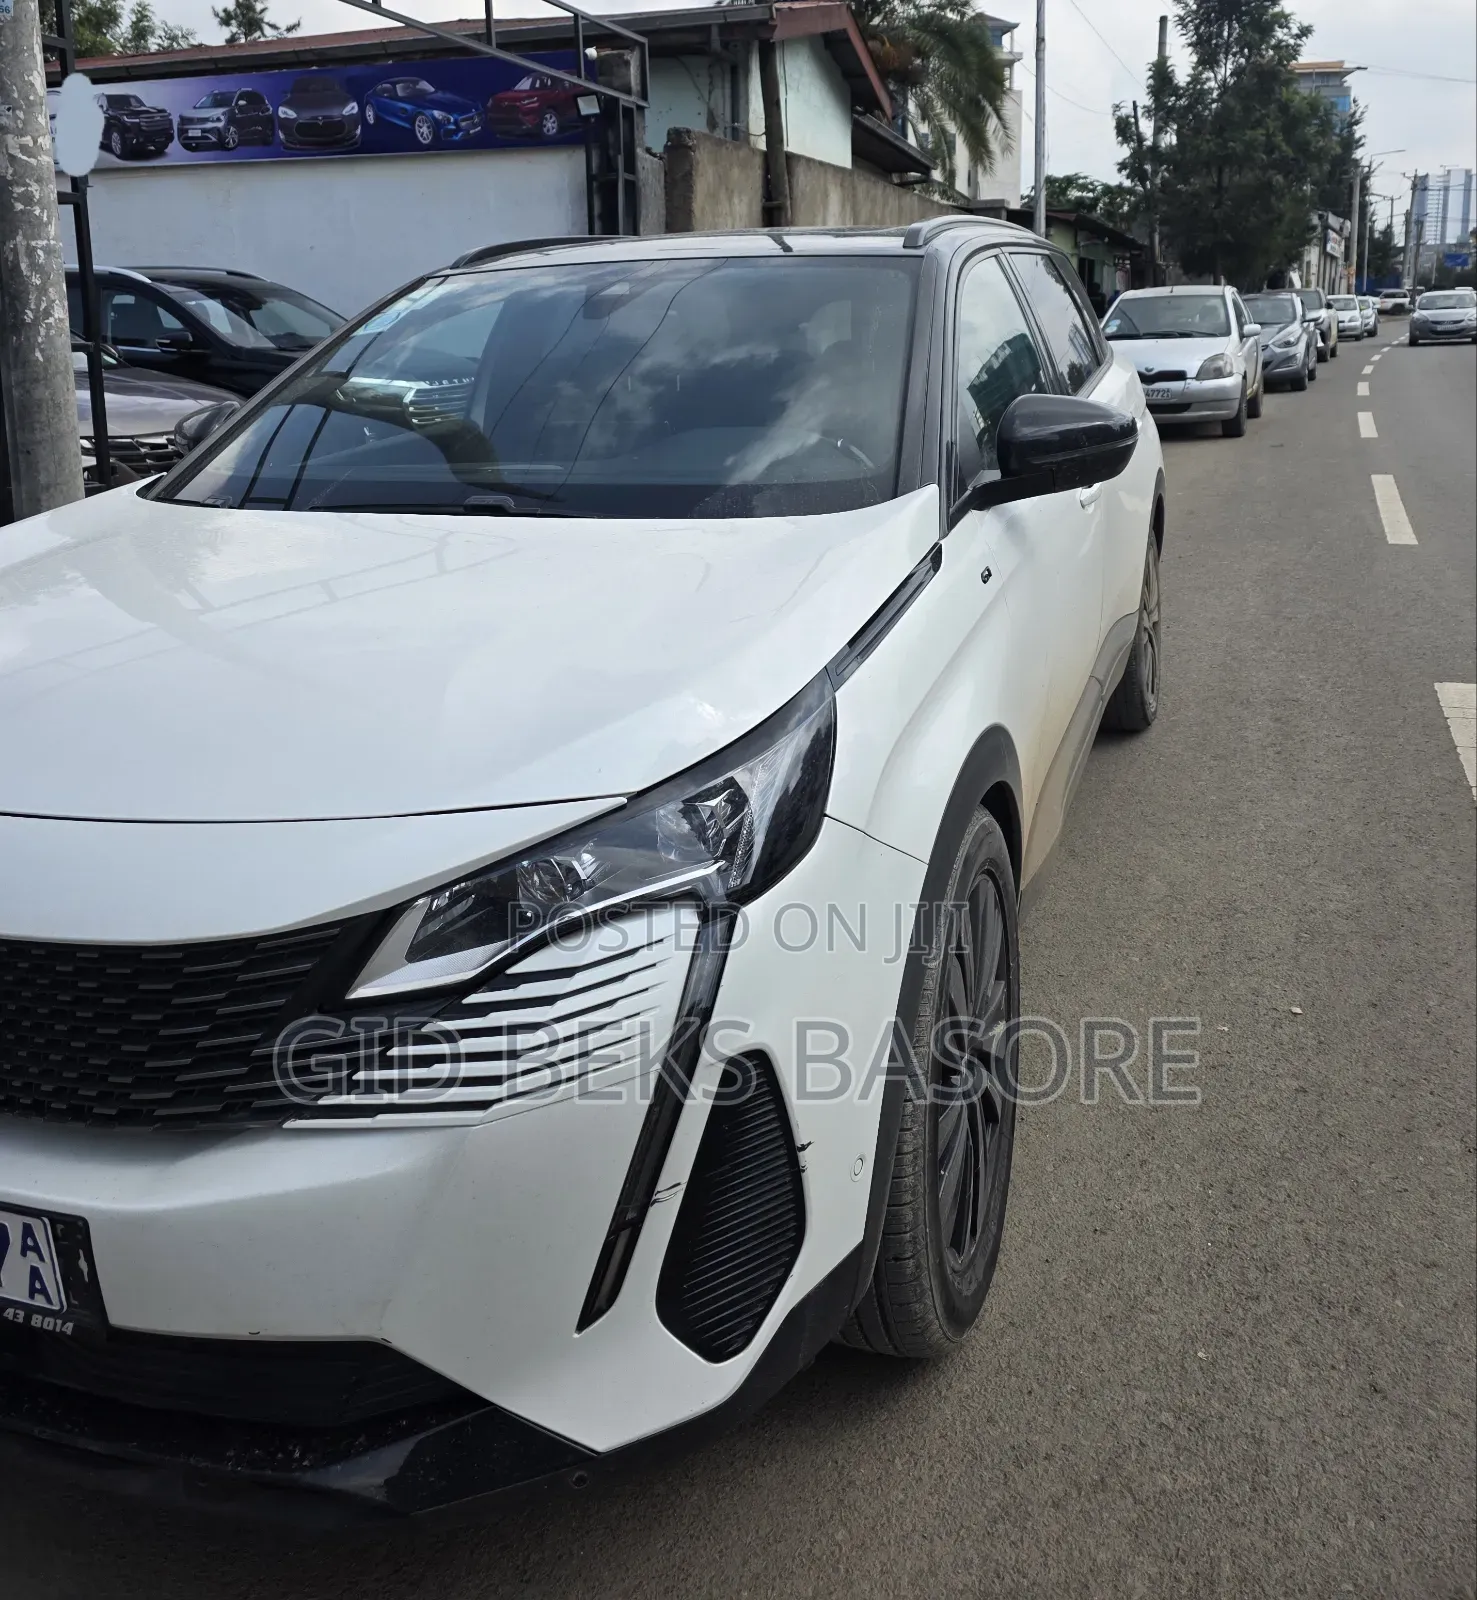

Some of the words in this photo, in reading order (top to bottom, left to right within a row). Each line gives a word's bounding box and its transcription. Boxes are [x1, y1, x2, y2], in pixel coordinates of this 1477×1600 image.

[20, 1221, 46, 1263] A
[28, 1264, 54, 1306] A
[3, 1307, 25, 1324] 43
[31, 1313, 74, 1336] 8014
